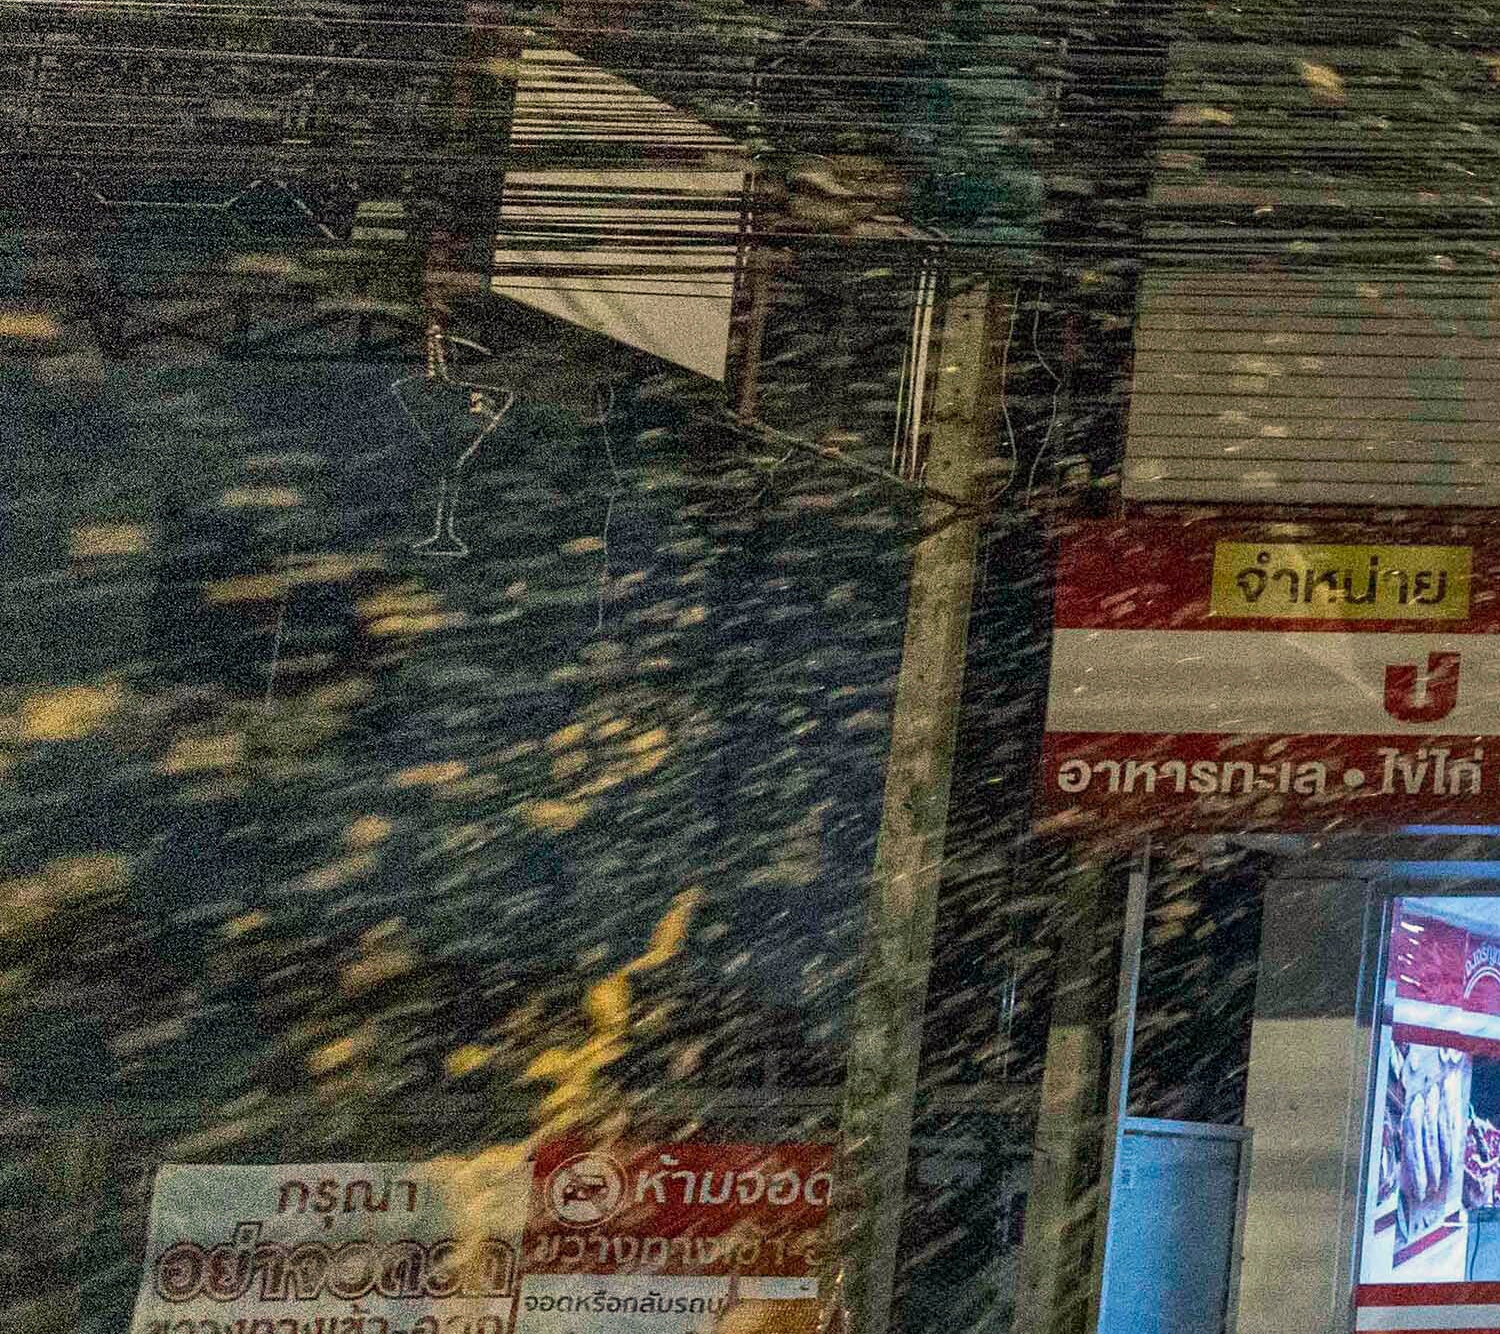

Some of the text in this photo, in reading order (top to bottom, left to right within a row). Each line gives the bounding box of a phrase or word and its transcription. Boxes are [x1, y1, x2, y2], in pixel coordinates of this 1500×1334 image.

[1235, 552, 1449, 606] จำหน่าย
[1057, 756, 1328, 795] อาหารทะเล
[1378, 746, 1485, 796] ไข่ไก่
[277, 1177, 418, 1230] กรุณา
